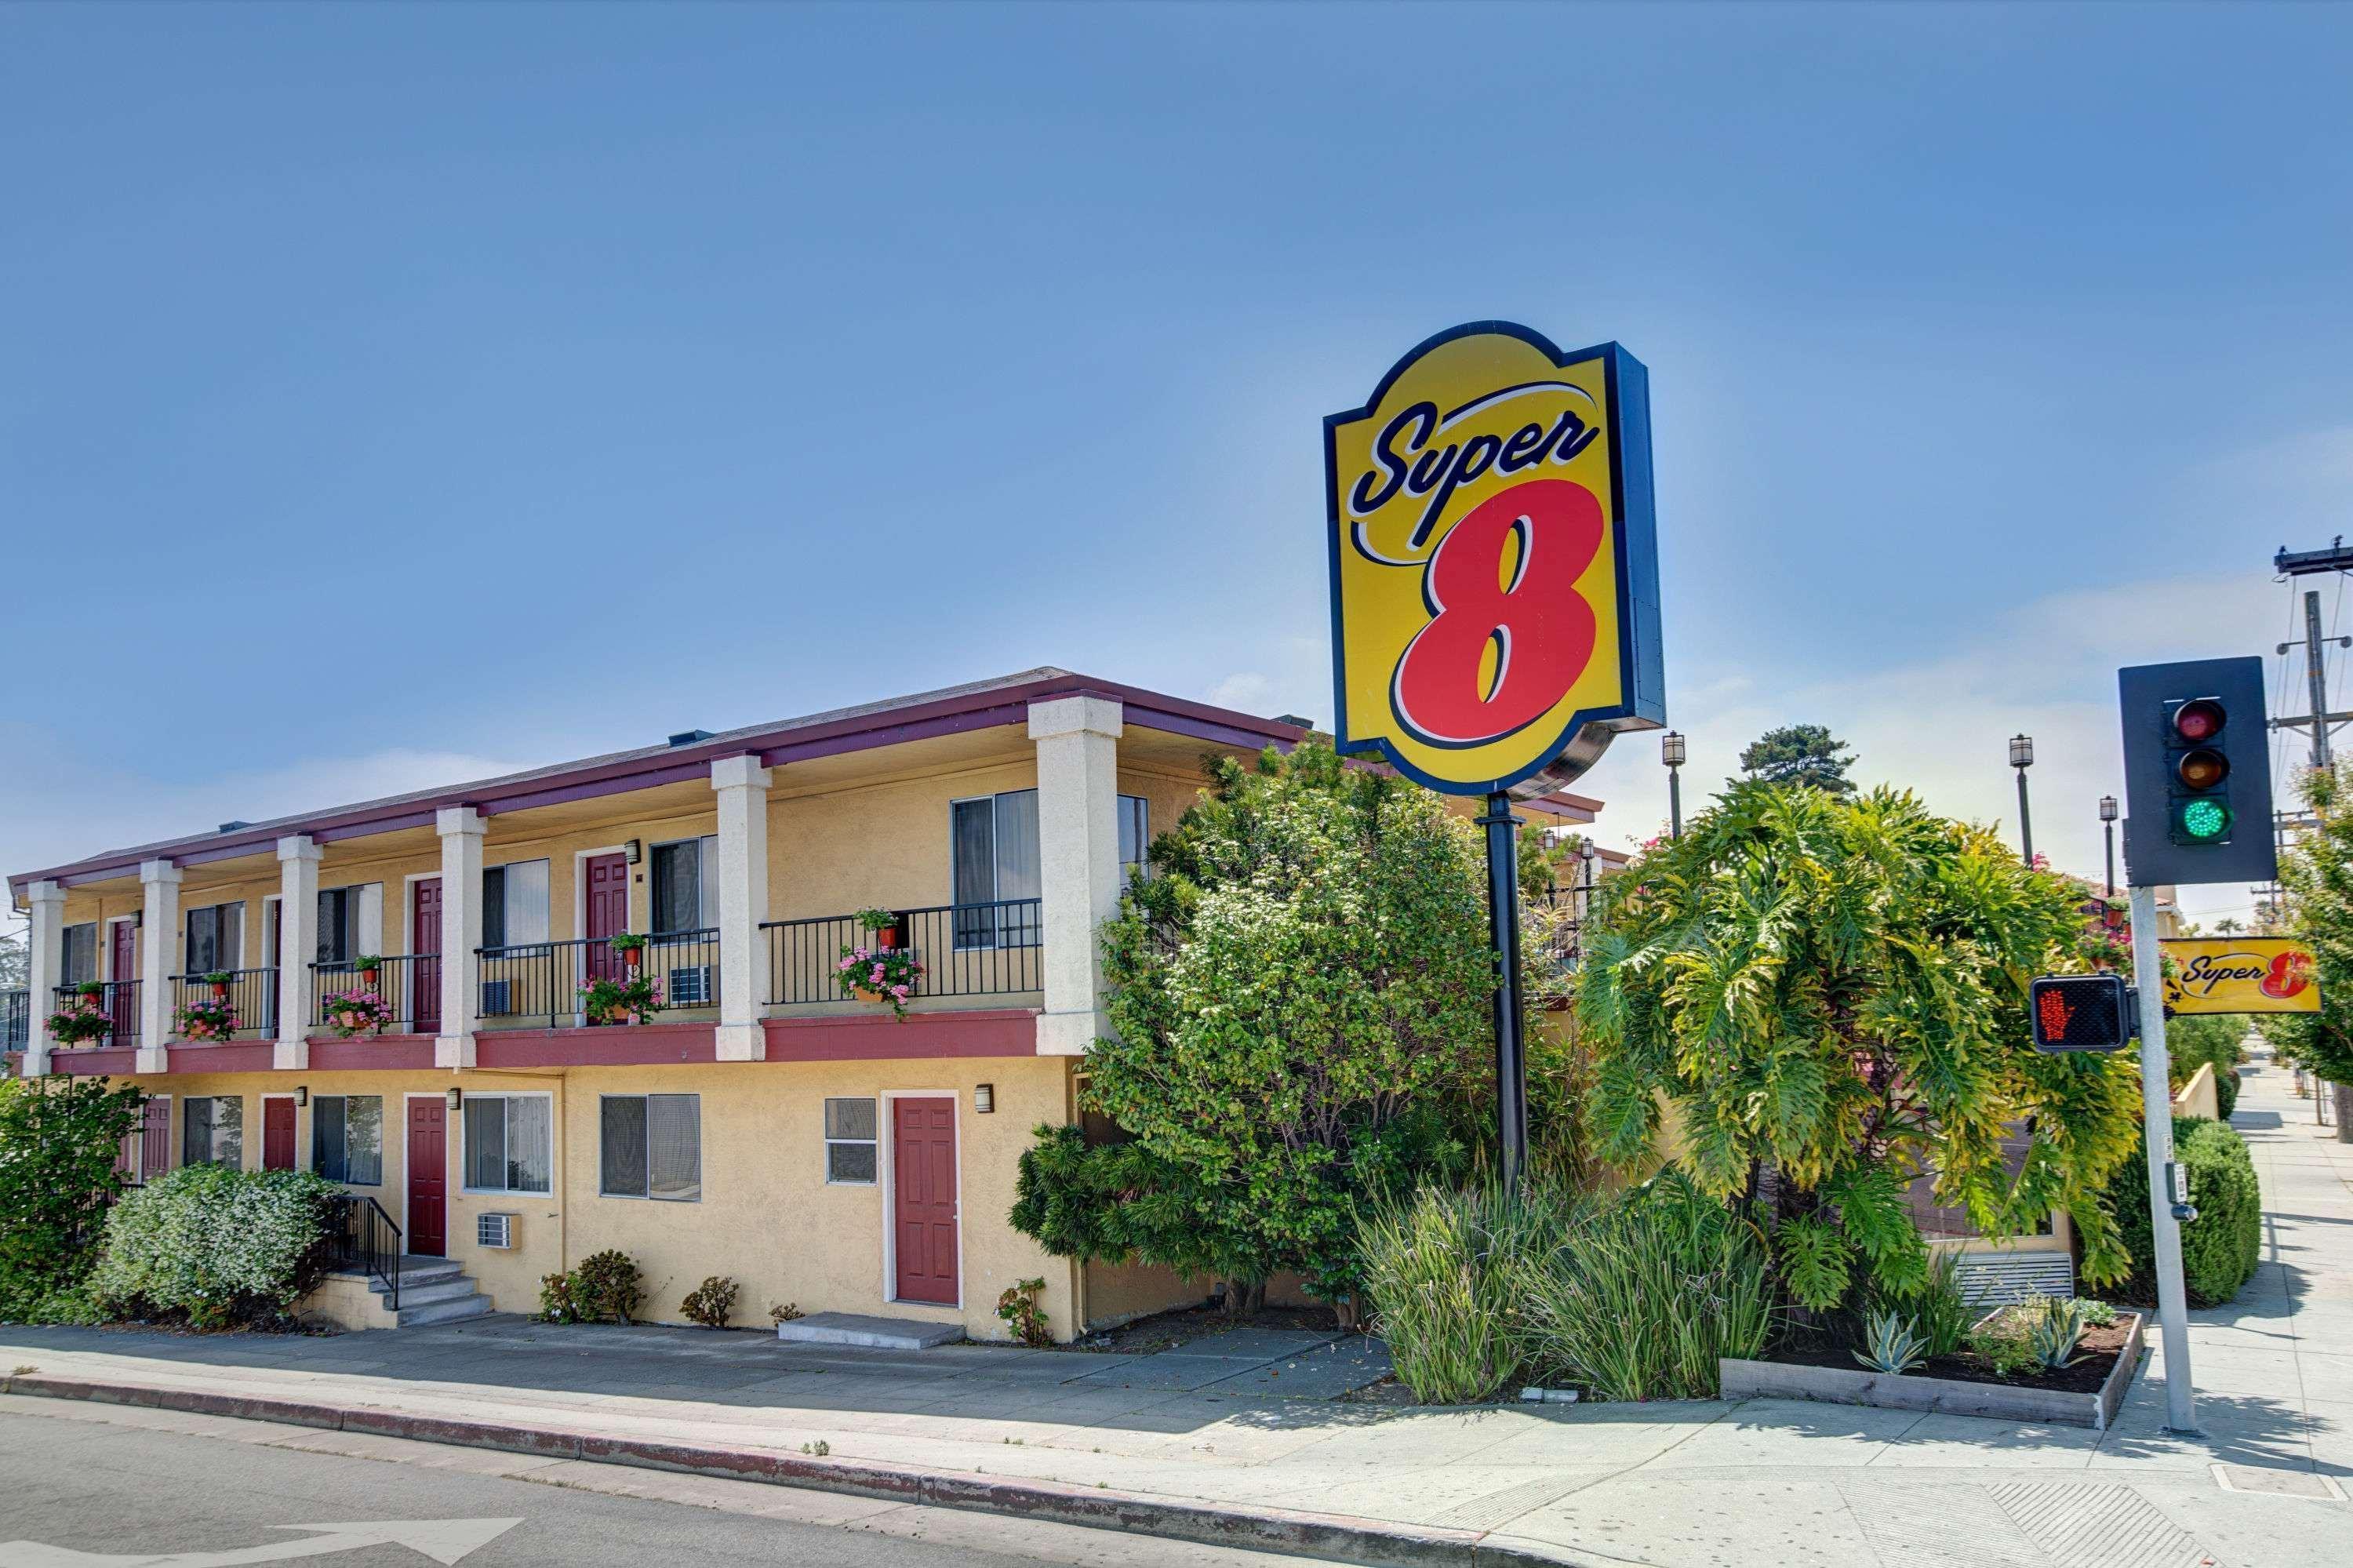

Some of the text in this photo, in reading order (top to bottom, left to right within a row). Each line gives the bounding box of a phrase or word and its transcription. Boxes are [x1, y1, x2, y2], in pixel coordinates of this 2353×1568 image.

[1349, 401, 1600, 548] Super
[1389, 478, 1604, 749] 8
[2182, 951, 2311, 999] Super 8
